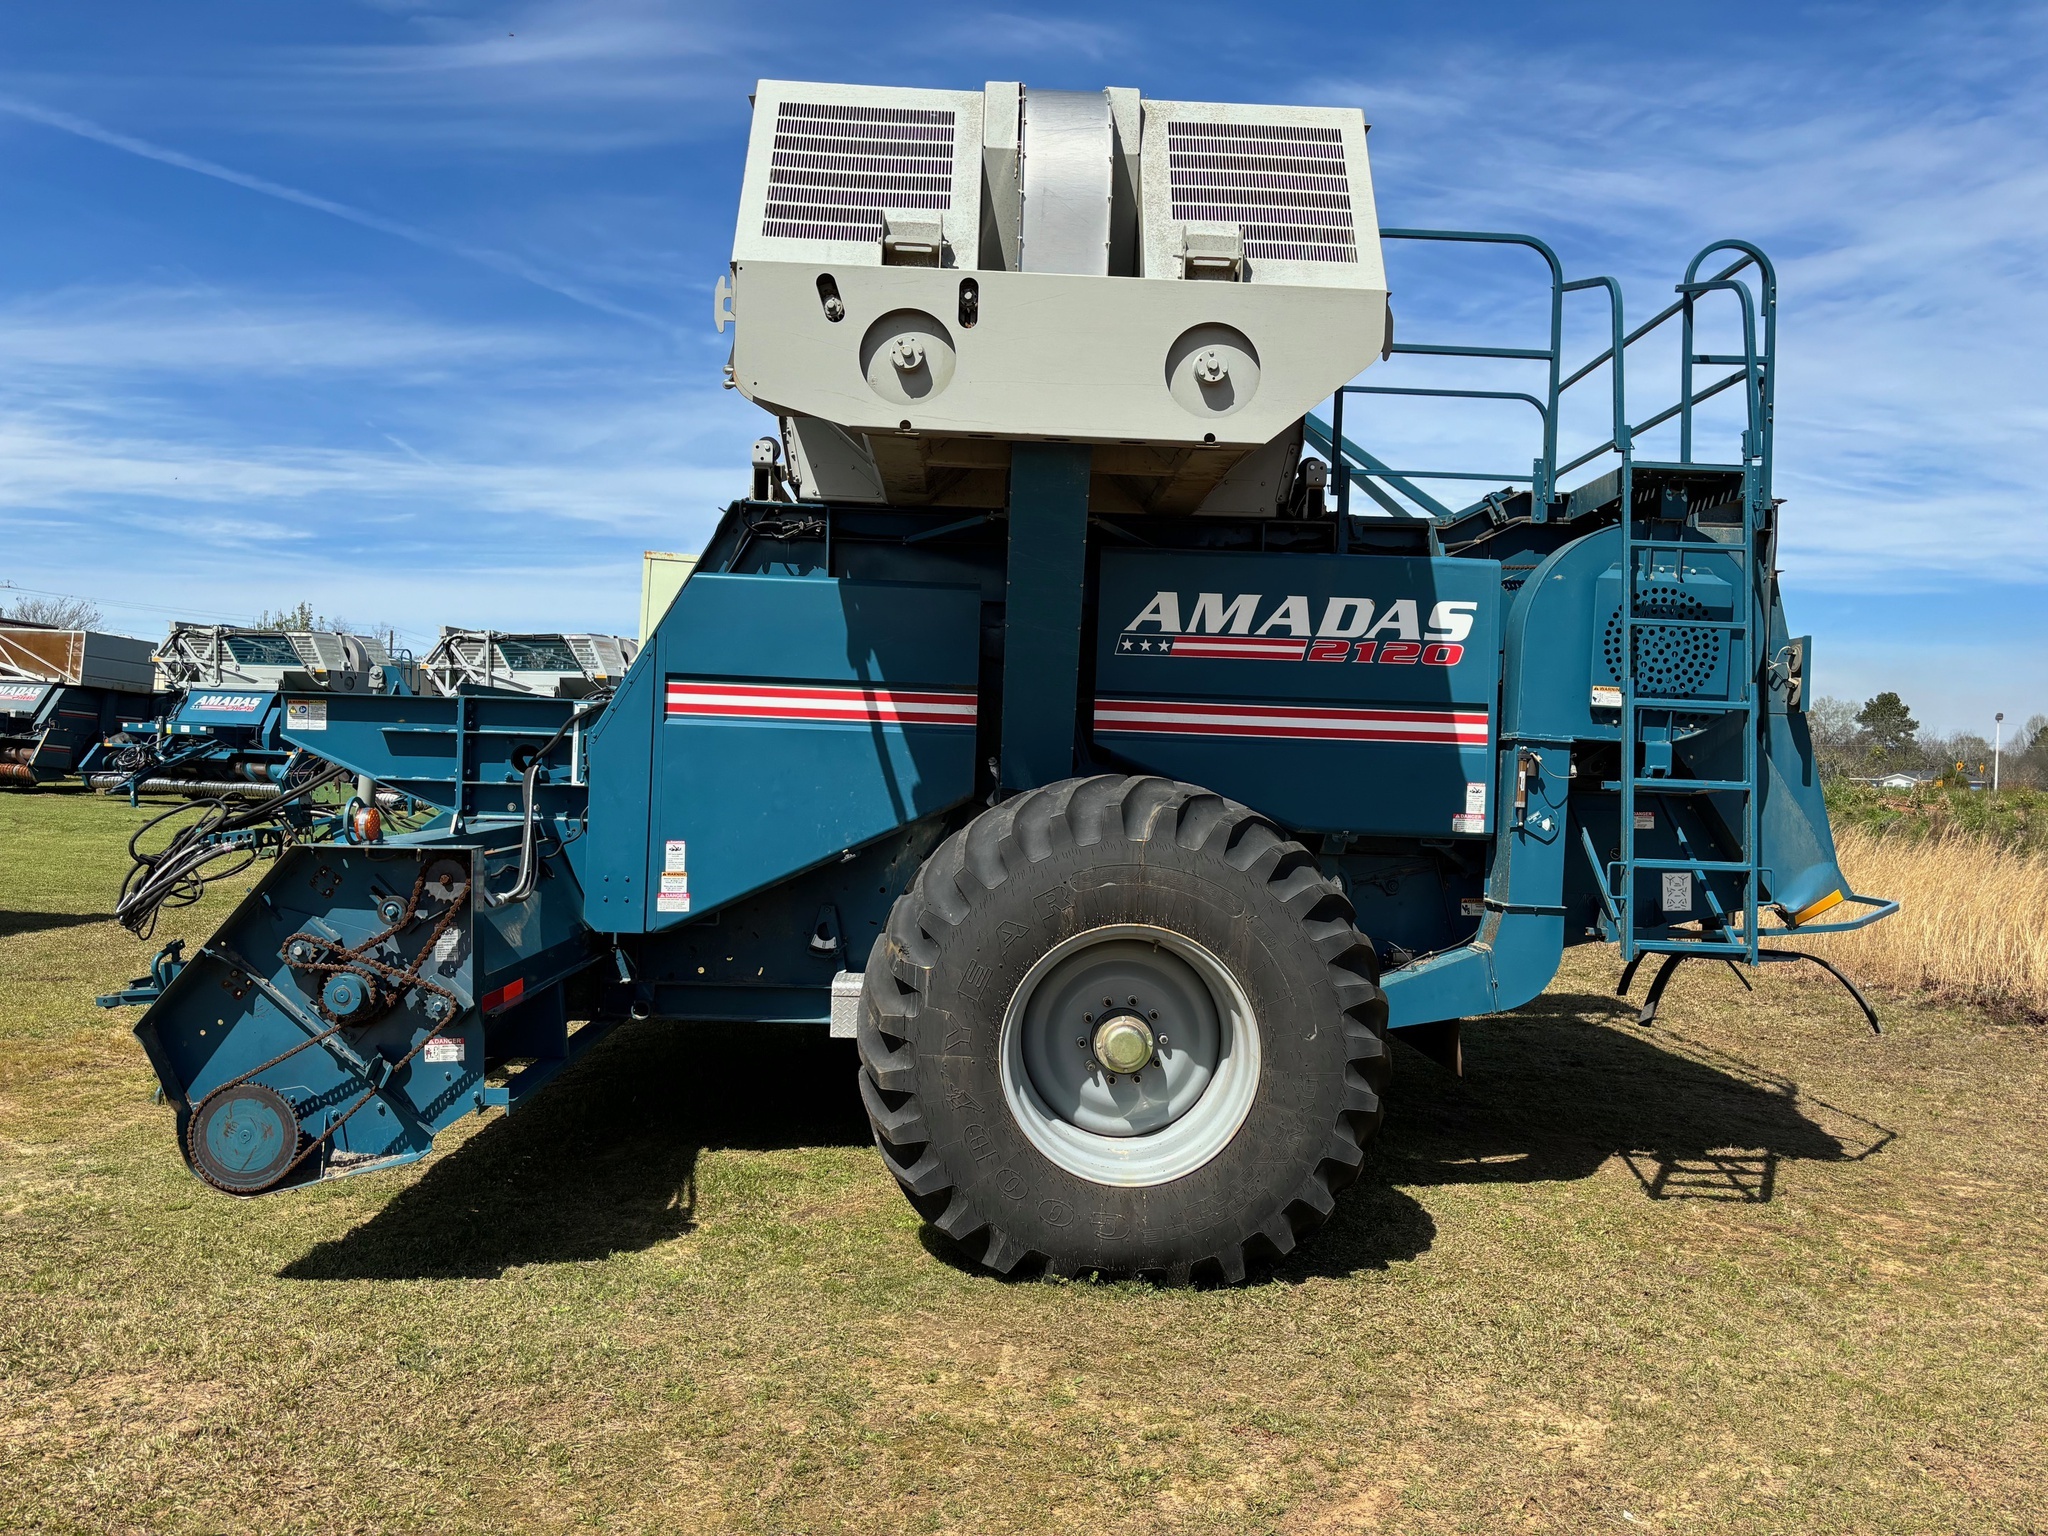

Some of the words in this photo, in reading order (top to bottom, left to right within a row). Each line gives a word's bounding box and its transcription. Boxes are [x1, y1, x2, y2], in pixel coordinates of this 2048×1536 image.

[1123, 591, 1478, 642] AMADAS
[1307, 639, 1465, 667] 2120
[0, 685, 44, 696] MADAS
[193, 695, 263, 707] AMADAS
